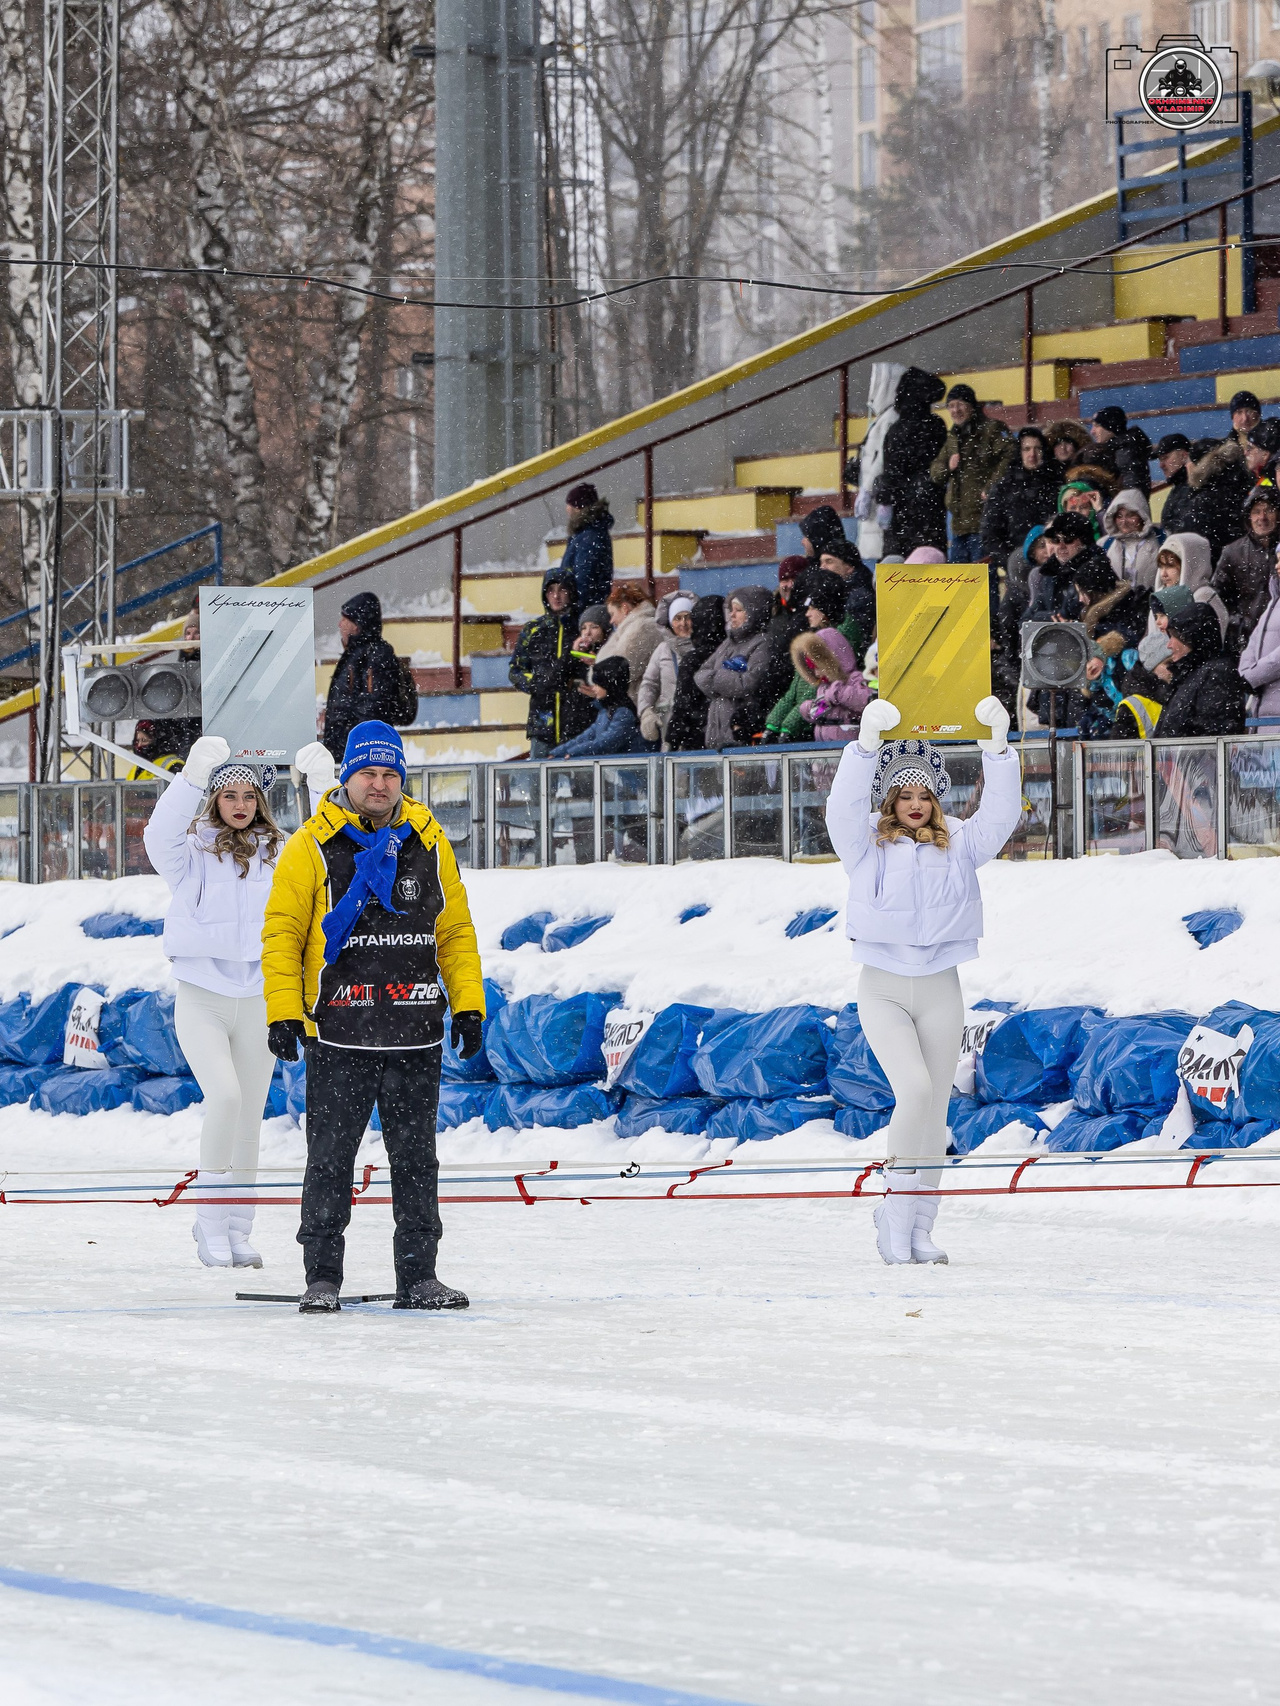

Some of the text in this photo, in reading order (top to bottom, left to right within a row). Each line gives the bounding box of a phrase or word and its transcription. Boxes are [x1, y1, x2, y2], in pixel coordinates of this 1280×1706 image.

[884, 570, 981, 592] Красногорск
[207, 593, 306, 616] Красногорск
[409, 983, 441, 1000] RG
